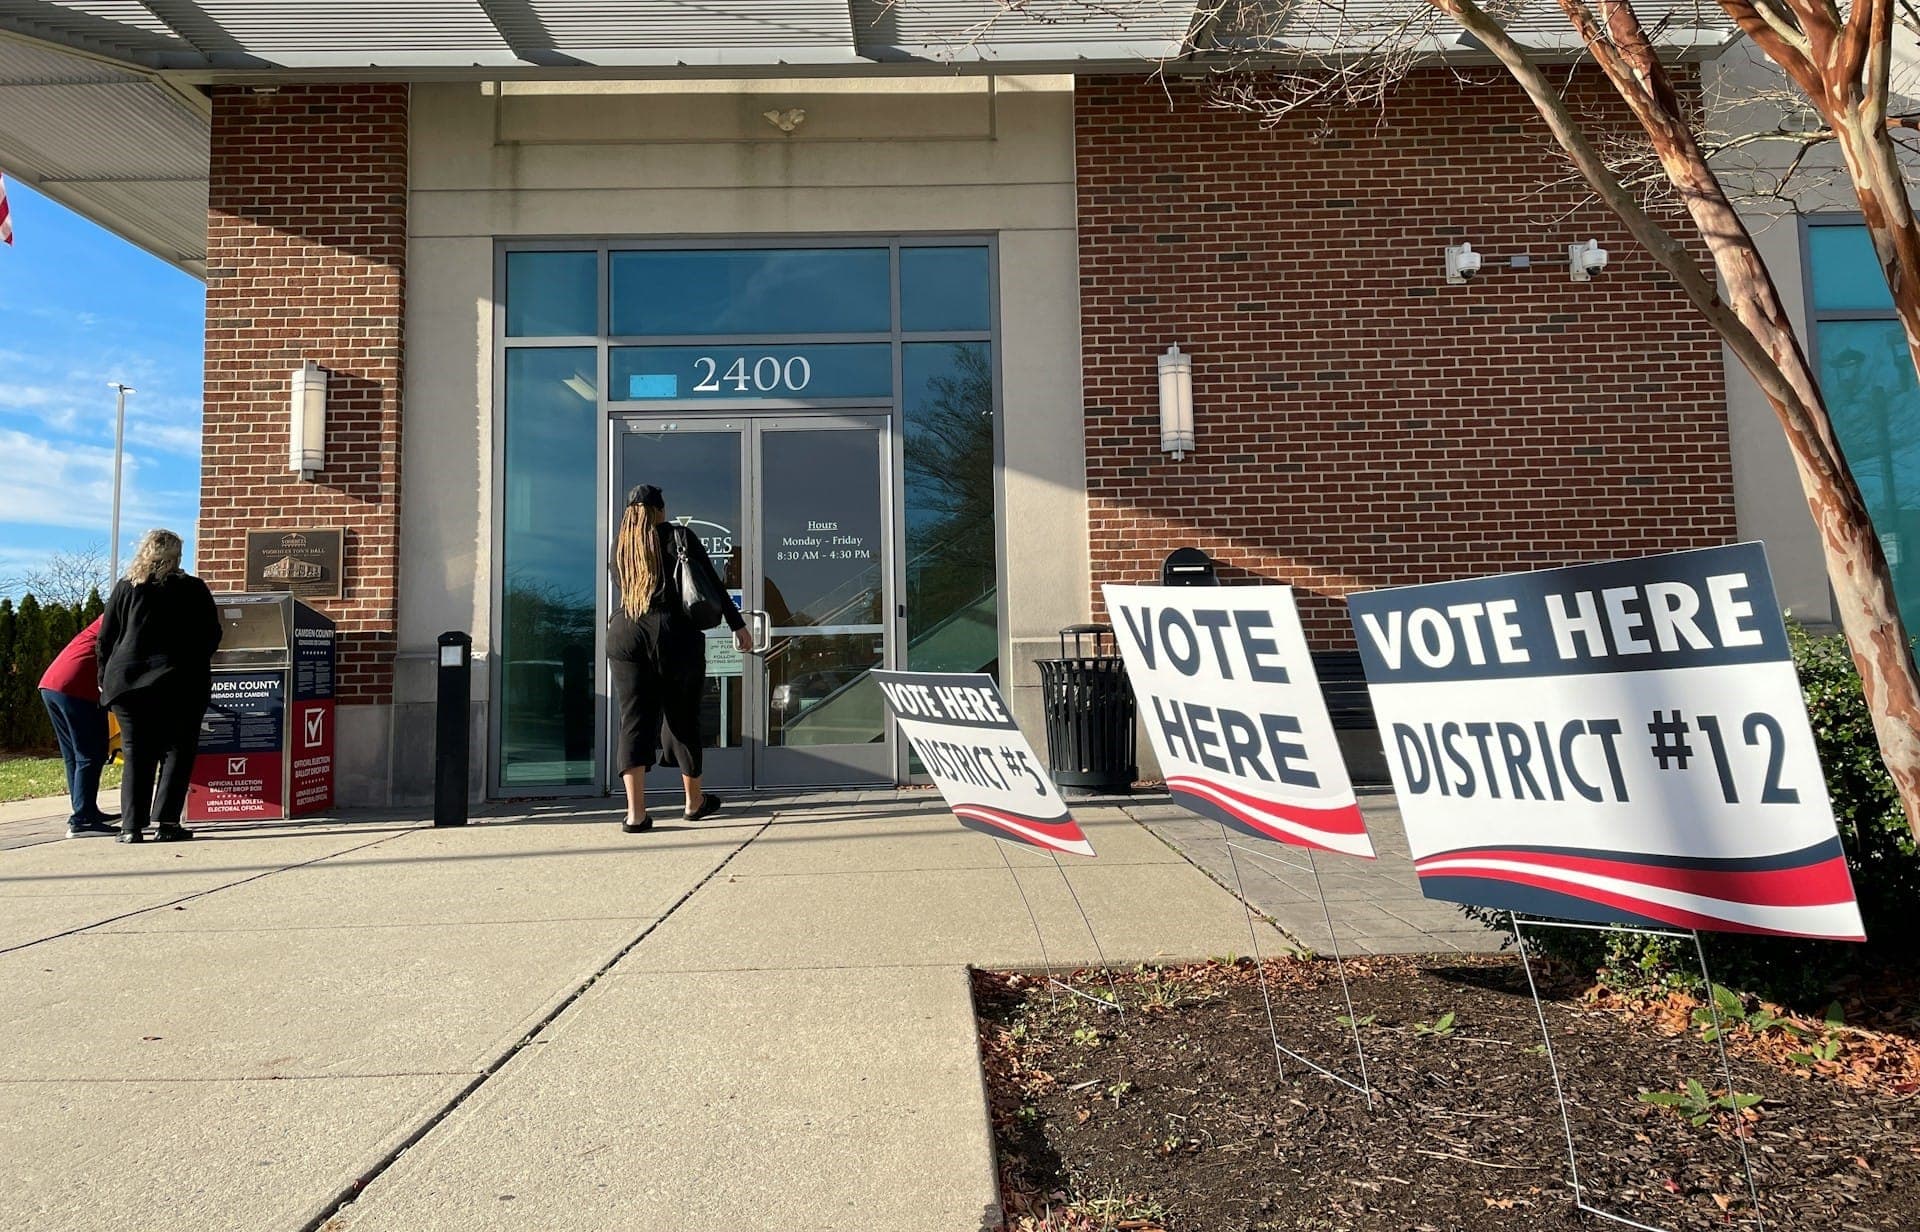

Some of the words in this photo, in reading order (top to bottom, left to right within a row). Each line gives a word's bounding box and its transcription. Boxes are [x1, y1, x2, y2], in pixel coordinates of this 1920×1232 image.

[692, 356, 811, 392] 2400
[782, 536, 821, 547] Monday
[832, 535, 863, 546] Friday
[808, 520, 838, 530] Hours
[777, 551, 799, 560] 8:30
[802, 550, 819, 560] AM
[829, 549, 851, 559] 4:30
[854, 549, 870, 558] PM
[1361, 599, 1531, 670] VOTE
[1544, 573, 1763, 660] HERE
[1119, 605, 1291, 684] VOTE
[239, 680, 280, 690] COUNTY
[879, 682, 943, 718] VOTE
[934, 686, 1009, 723] HERE
[1151, 695, 1321, 789] HERE
[1392, 718, 1631, 802] DISTRICT
[1647, 710, 1801, 804] #12
[914, 737, 1011, 791] DISTRICT
[1000, 746, 1047, 797] #5
